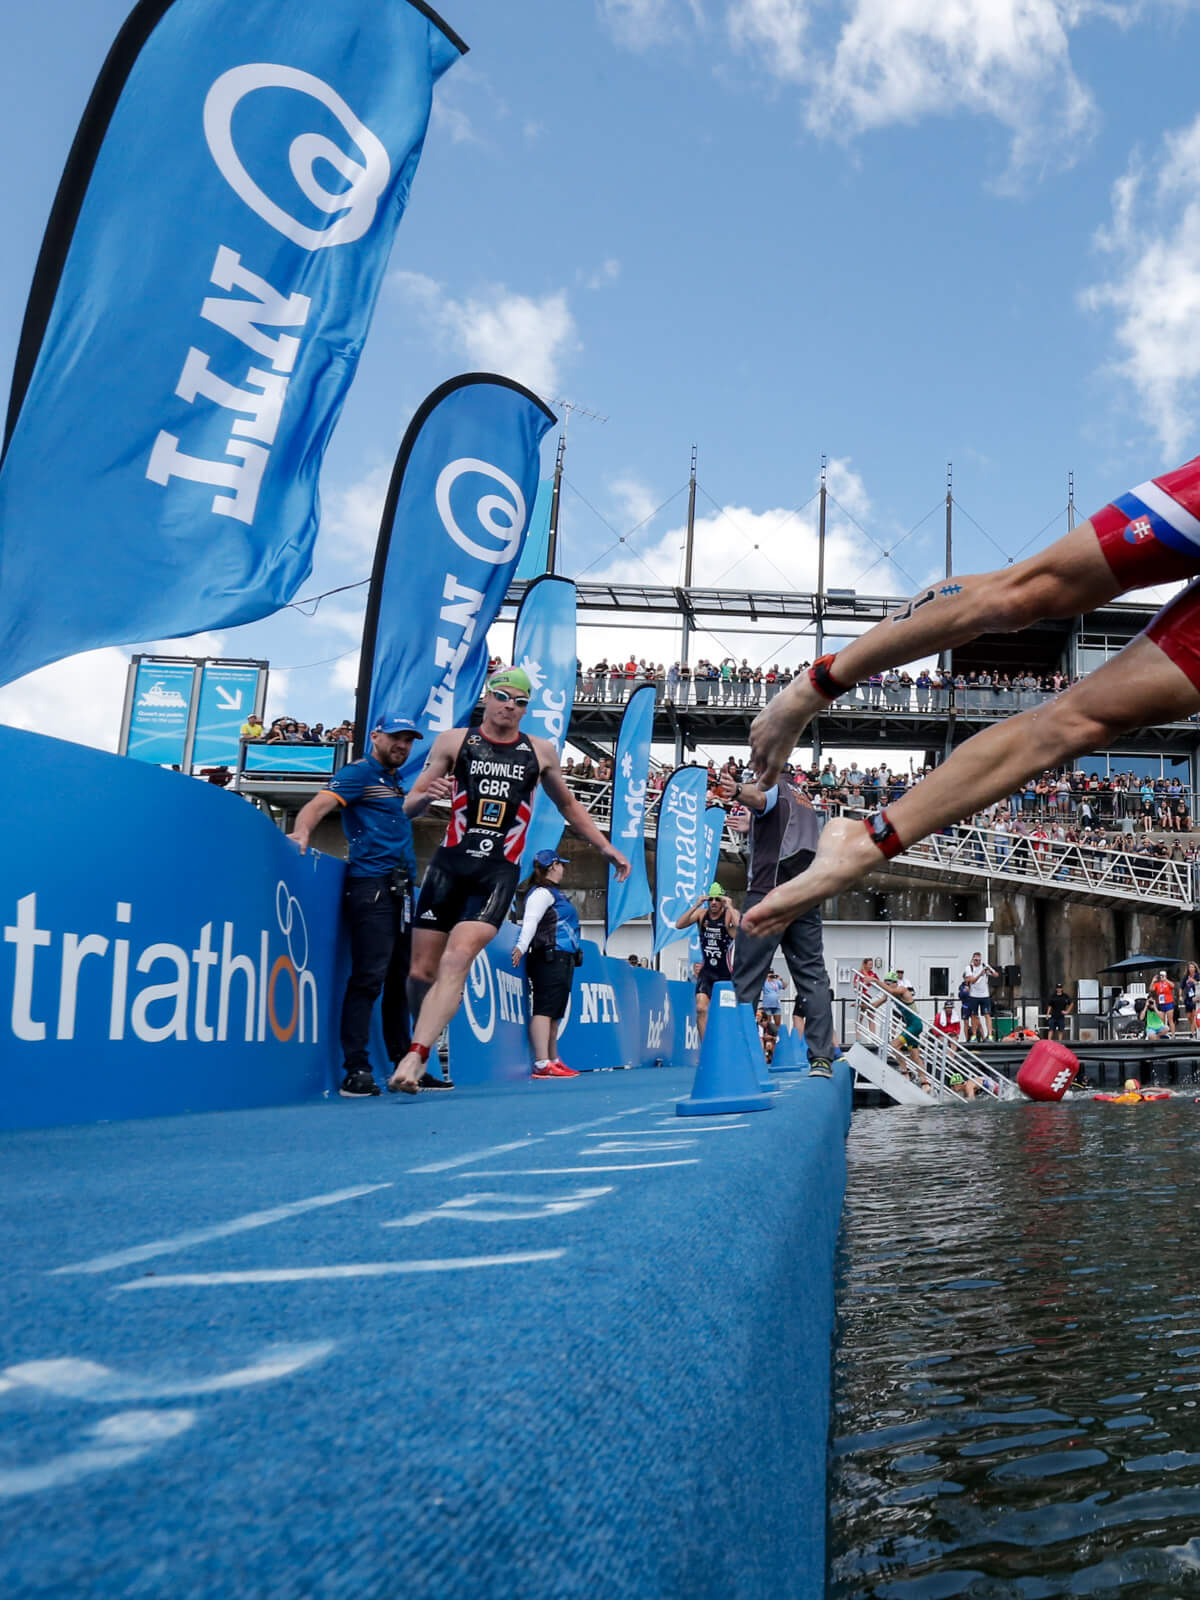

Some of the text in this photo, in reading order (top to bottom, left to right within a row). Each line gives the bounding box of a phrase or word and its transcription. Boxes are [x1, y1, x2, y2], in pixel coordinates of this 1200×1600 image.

[145, 245, 311, 525] NTT
[470, 760, 525, 780] BROWNLEE
[479, 778, 510, 798] GBR
[659, 791, 698, 930] Canada
[4, 891, 318, 1044] triathlon
[496, 968, 525, 1025] NTT
[579, 983, 620, 1024] NTT
